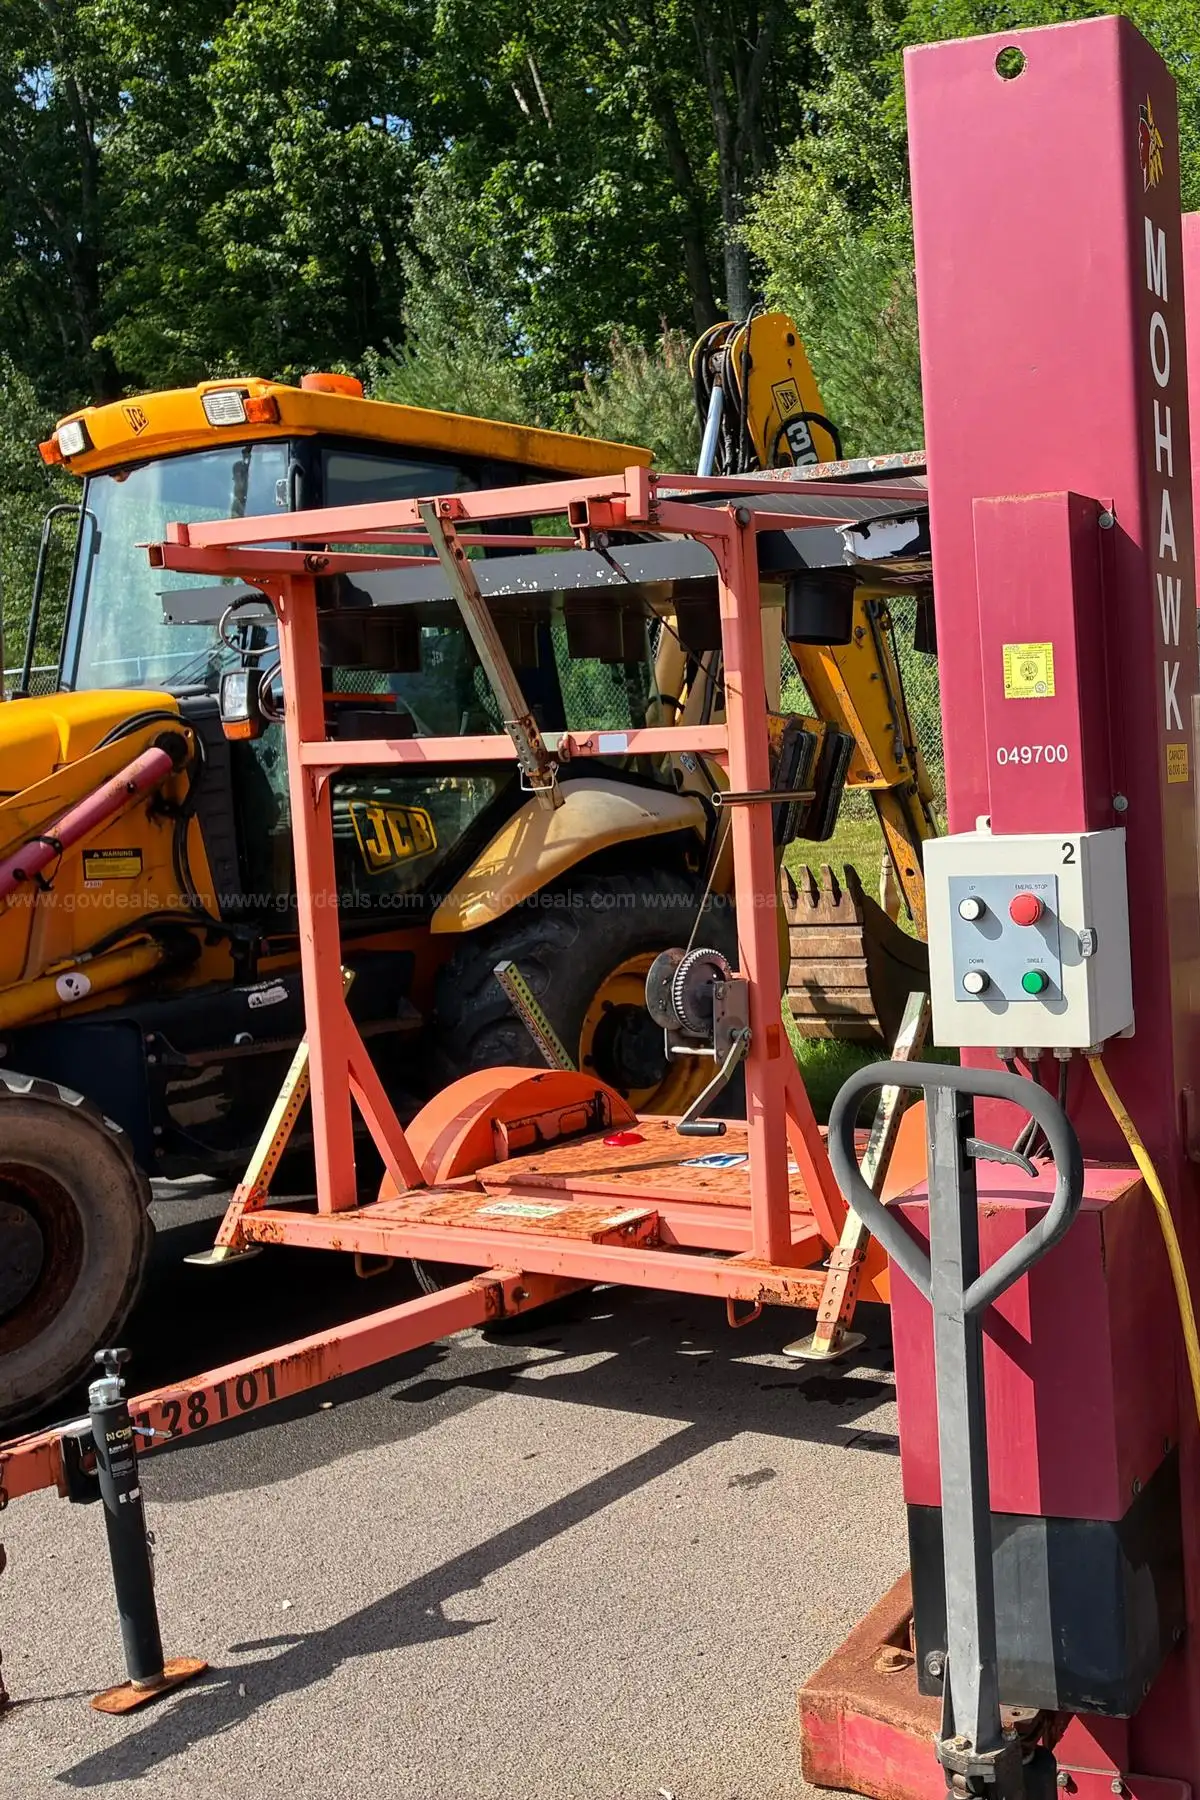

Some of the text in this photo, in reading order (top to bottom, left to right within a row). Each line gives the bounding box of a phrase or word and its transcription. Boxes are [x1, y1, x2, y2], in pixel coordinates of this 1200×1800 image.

[126, 408, 147, 432] JCB
[1144, 215, 1183, 731] MOHAWK
[996, 744, 1069, 765] 049700
[366, 808, 432, 866] JCB
[1061, 842, 1076, 865] 2
[136, 1367, 278, 1447] 128101
